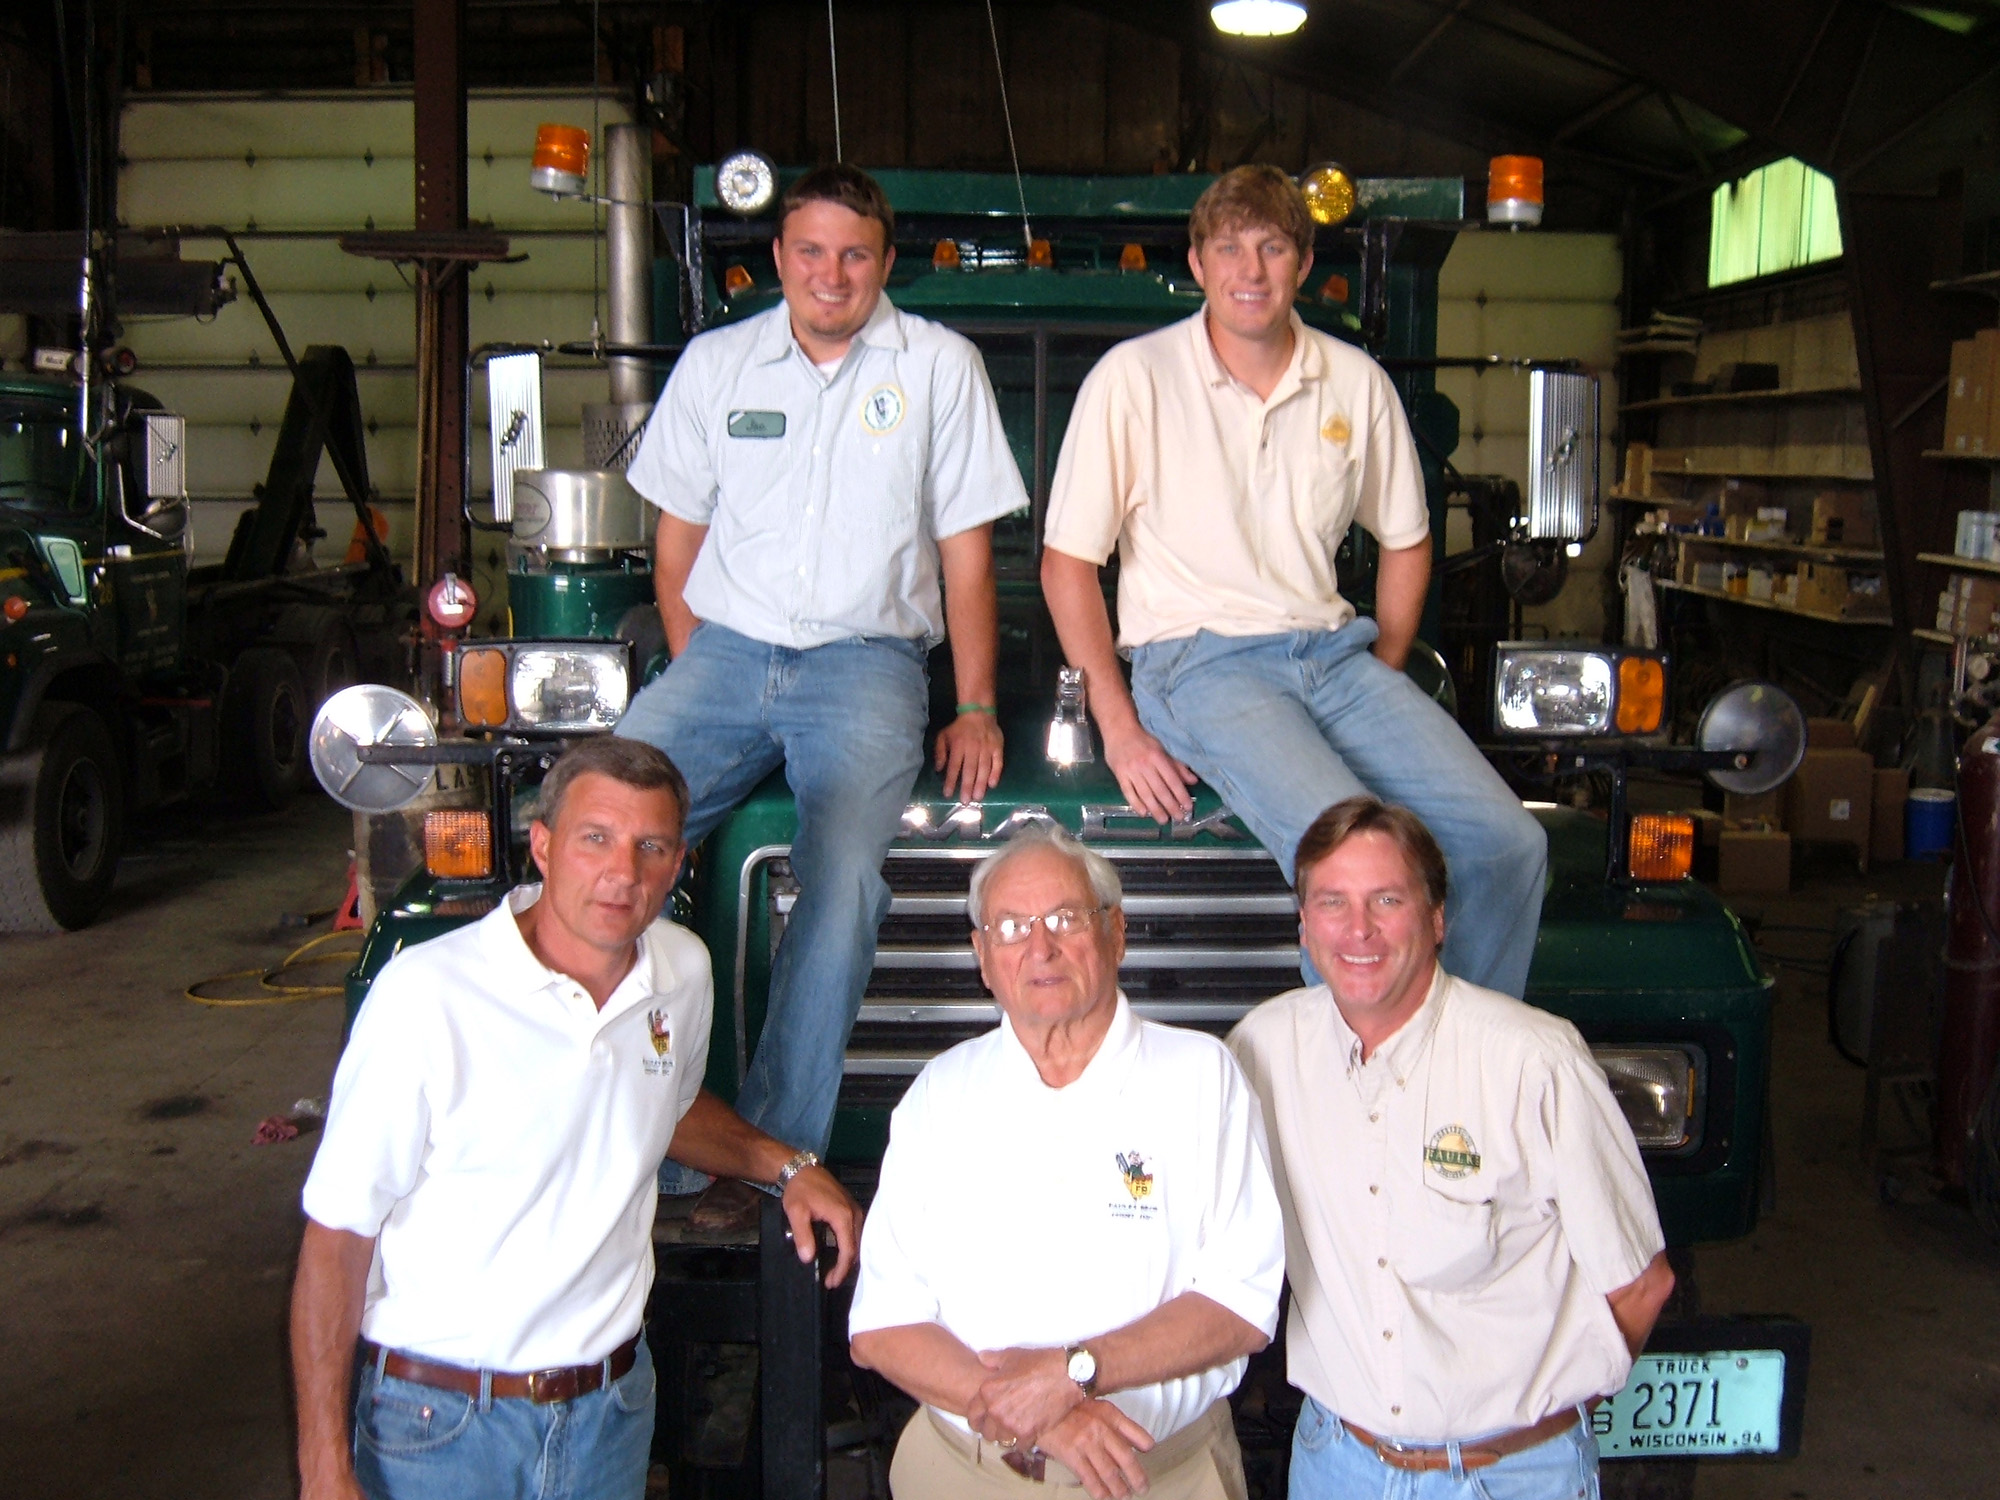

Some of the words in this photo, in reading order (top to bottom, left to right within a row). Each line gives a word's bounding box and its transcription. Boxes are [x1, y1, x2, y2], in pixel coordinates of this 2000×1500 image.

[1656, 1359, 1710, 1375] TRUCK
[1633, 1379, 1721, 1430] 2371
[1629, 1433, 1726, 1449] WISCONSIN
